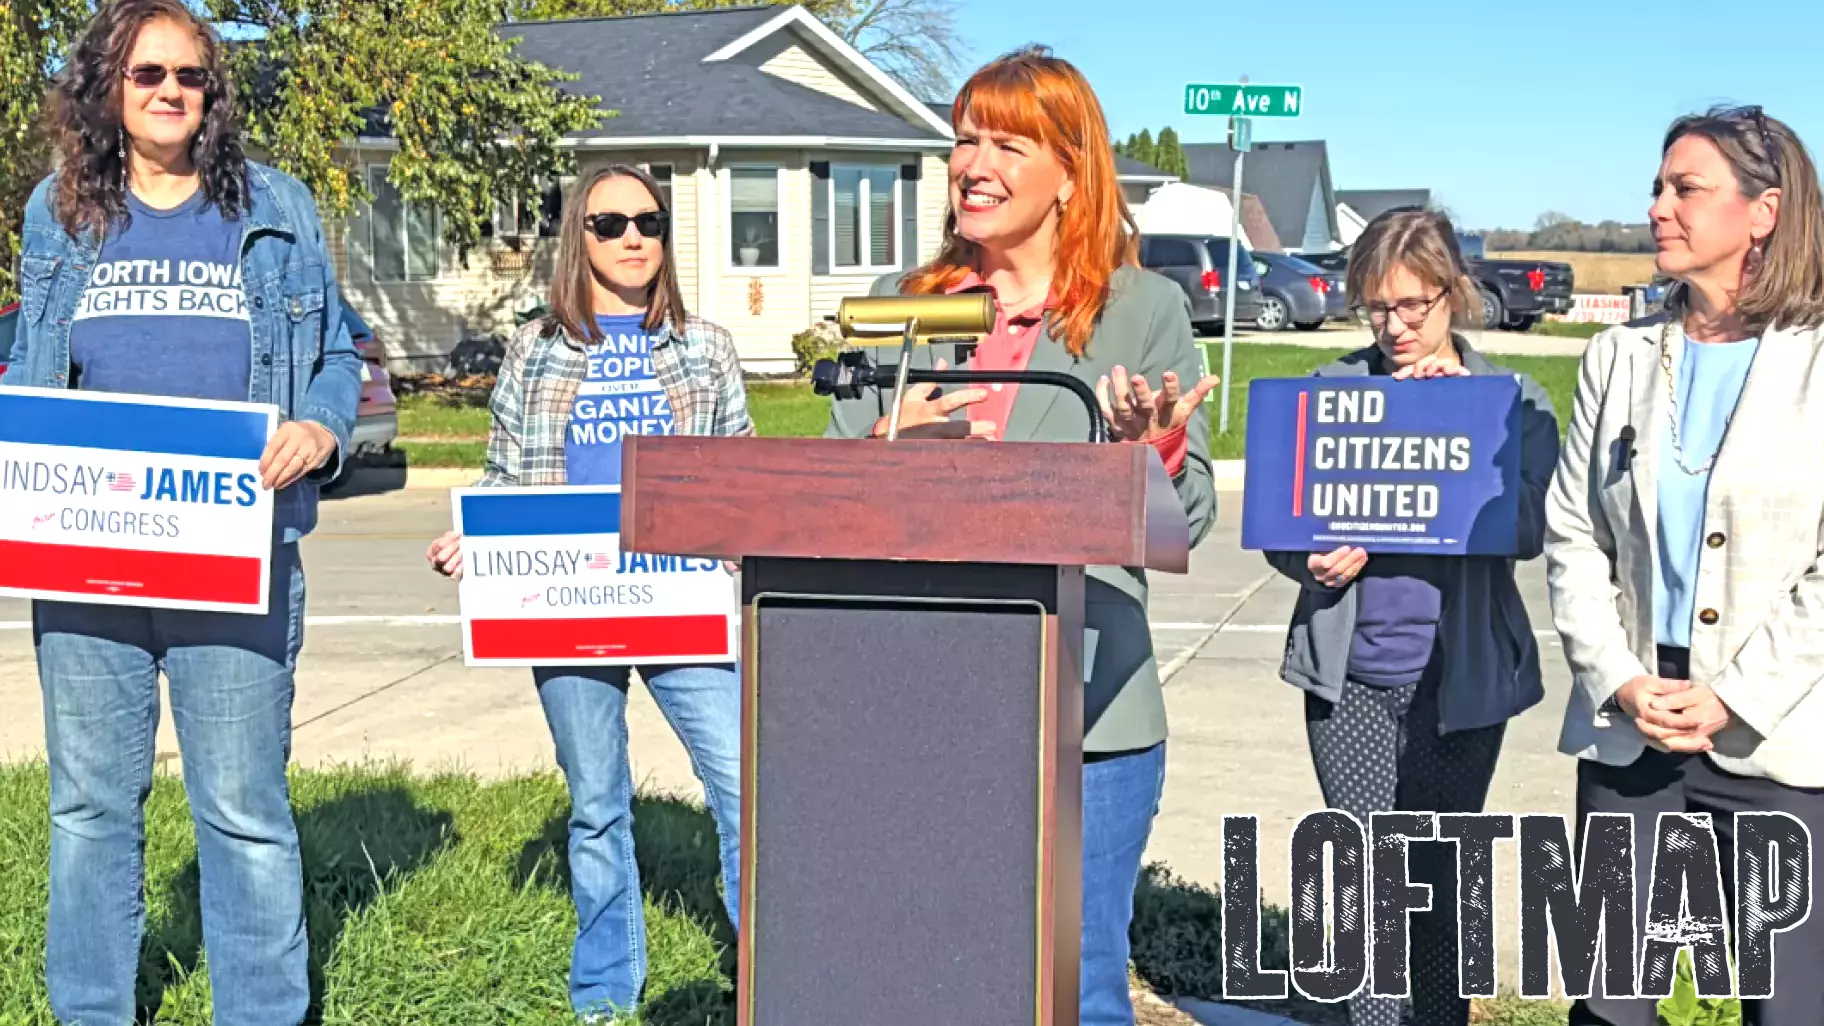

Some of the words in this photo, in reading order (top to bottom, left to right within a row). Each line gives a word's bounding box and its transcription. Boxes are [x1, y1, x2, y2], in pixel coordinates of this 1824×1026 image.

[1187, 88, 1222, 111] 10th
[1231, 89, 1271, 112] Ave
[1283, 90, 1298, 112] N
[91, 259, 170, 286] ORTH
[85, 289, 169, 313] IGHTS
[1317, 390, 1385, 423] END
[1314, 436, 1472, 471] CITIZENS
[2, 459, 105, 496] INDSAY
[140, 466, 257, 507] JAMES
[1312, 483, 1439, 518] UNITED
[60, 506, 181, 538] CONGRESS
[472, 548, 581, 577] LINDSAY
[546, 584, 654, 607] CONGRESS
